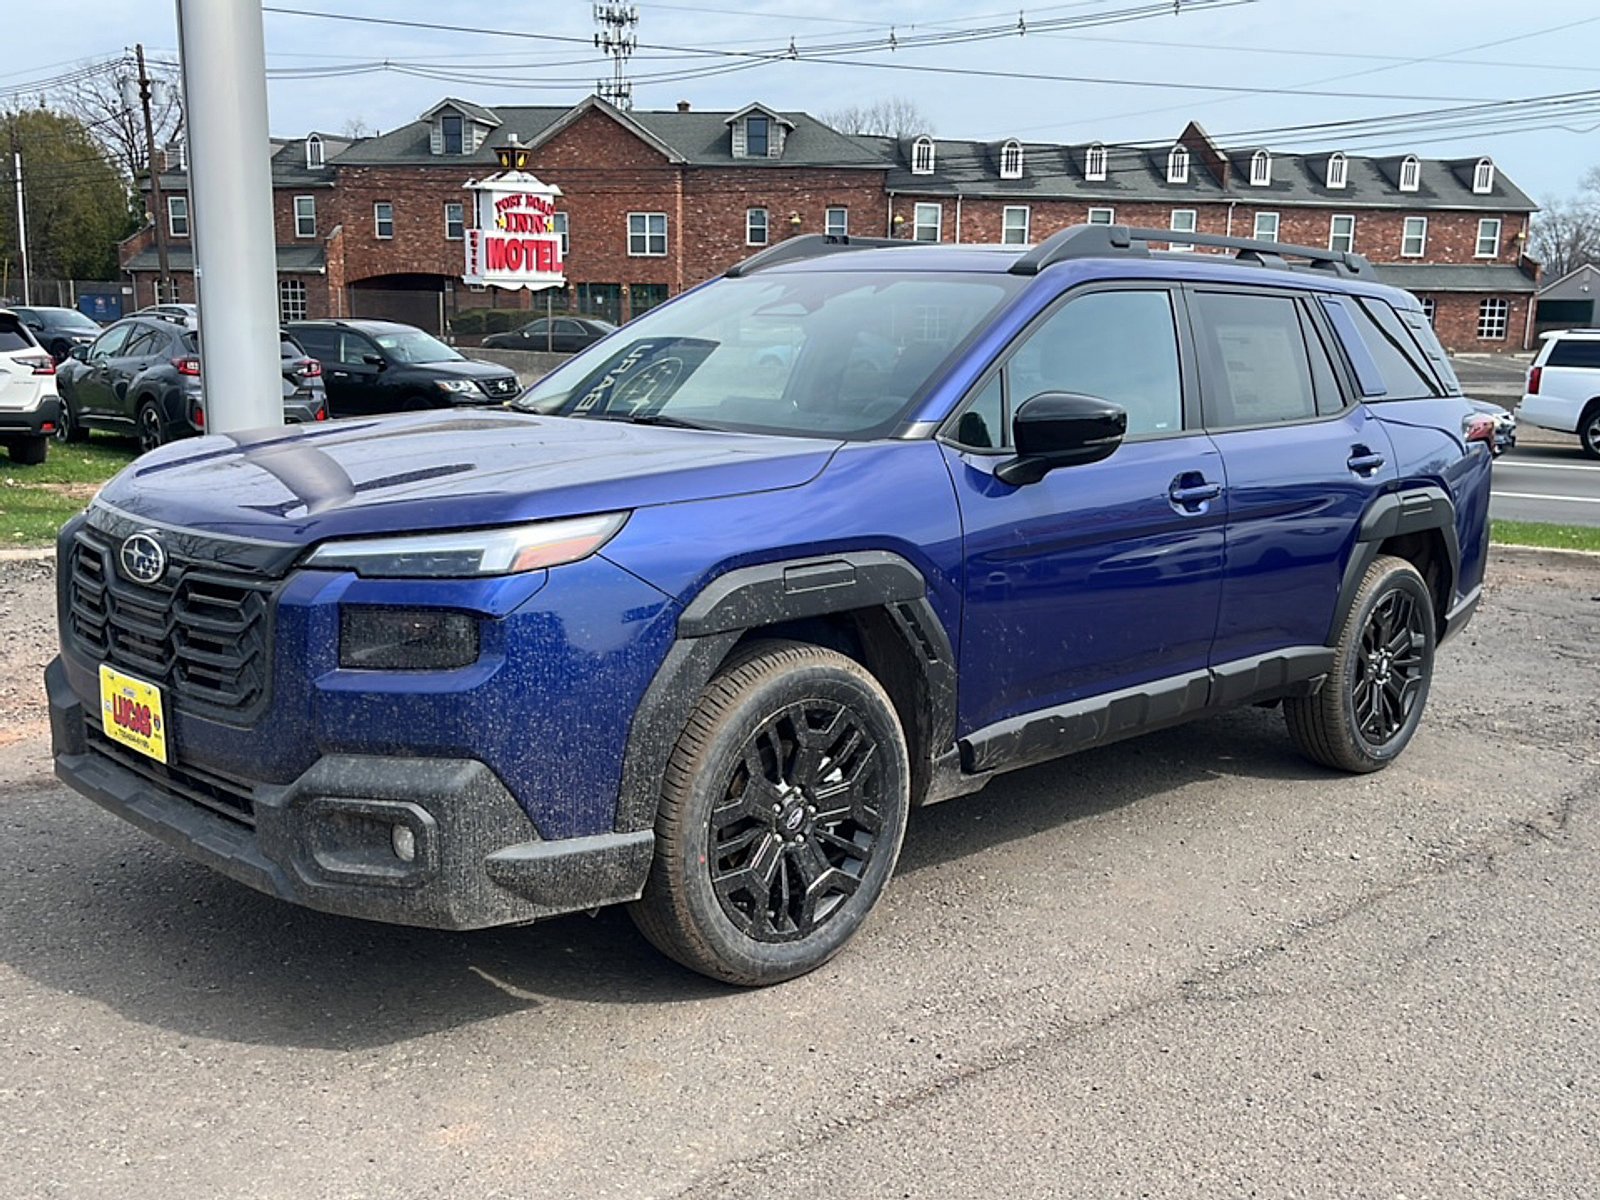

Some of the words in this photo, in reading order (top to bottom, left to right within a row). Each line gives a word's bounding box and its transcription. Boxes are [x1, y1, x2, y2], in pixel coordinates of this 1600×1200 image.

[495, 194, 523, 213] POST
[525, 194, 557, 217] ROAD
[505, 212, 546, 234] INN
[470, 231, 479, 276] MOTEL
[485, 237, 565, 273] MOTEL
[112, 692, 152, 739] LUCAS
